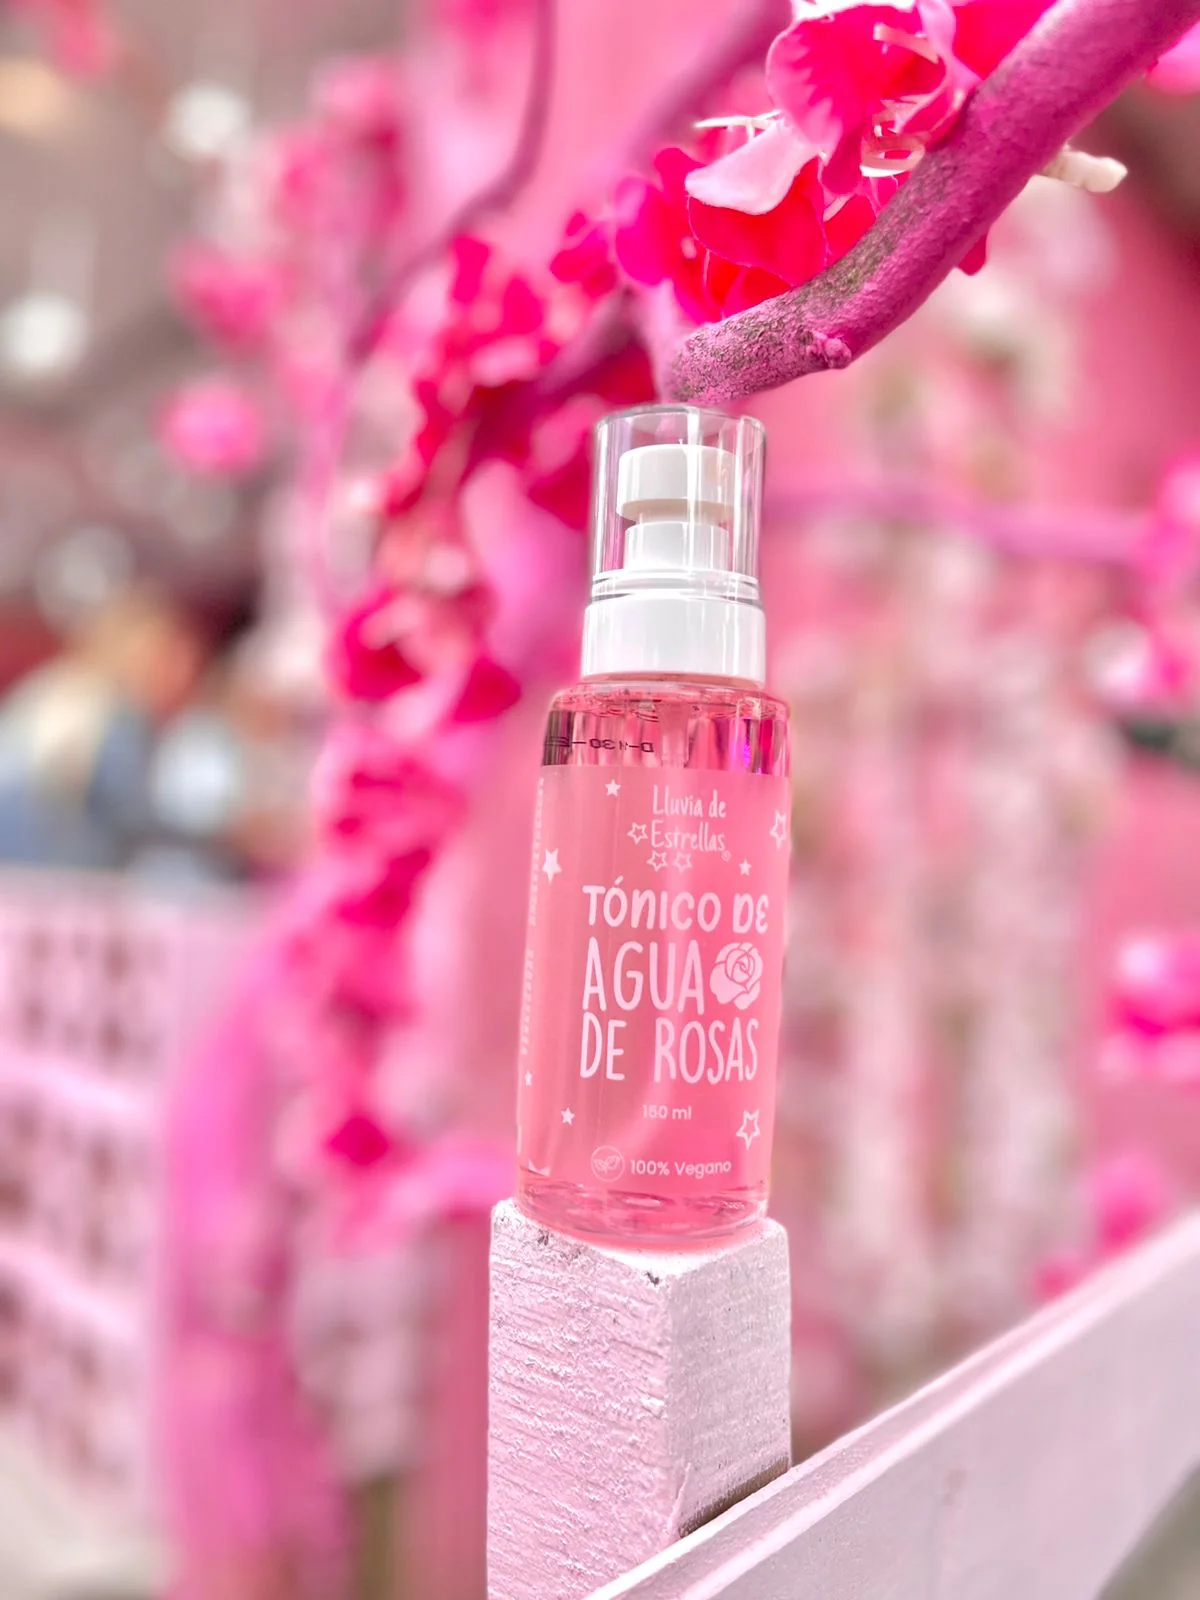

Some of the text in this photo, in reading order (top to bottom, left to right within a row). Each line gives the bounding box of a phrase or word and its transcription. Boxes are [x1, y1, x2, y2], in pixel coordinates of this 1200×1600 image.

[652, 784, 727, 818] Lluvia de
[651, 819, 727, 853] Estrellas
[582, 875, 769, 934] TÓNICO DE
[582, 936, 705, 1015] AGUA
[579, 1011, 759, 1085] DE ROSAS
[642, 1104, 692, 1120] 150 ml
[630, 1159, 732, 1179] 100% Vegano
